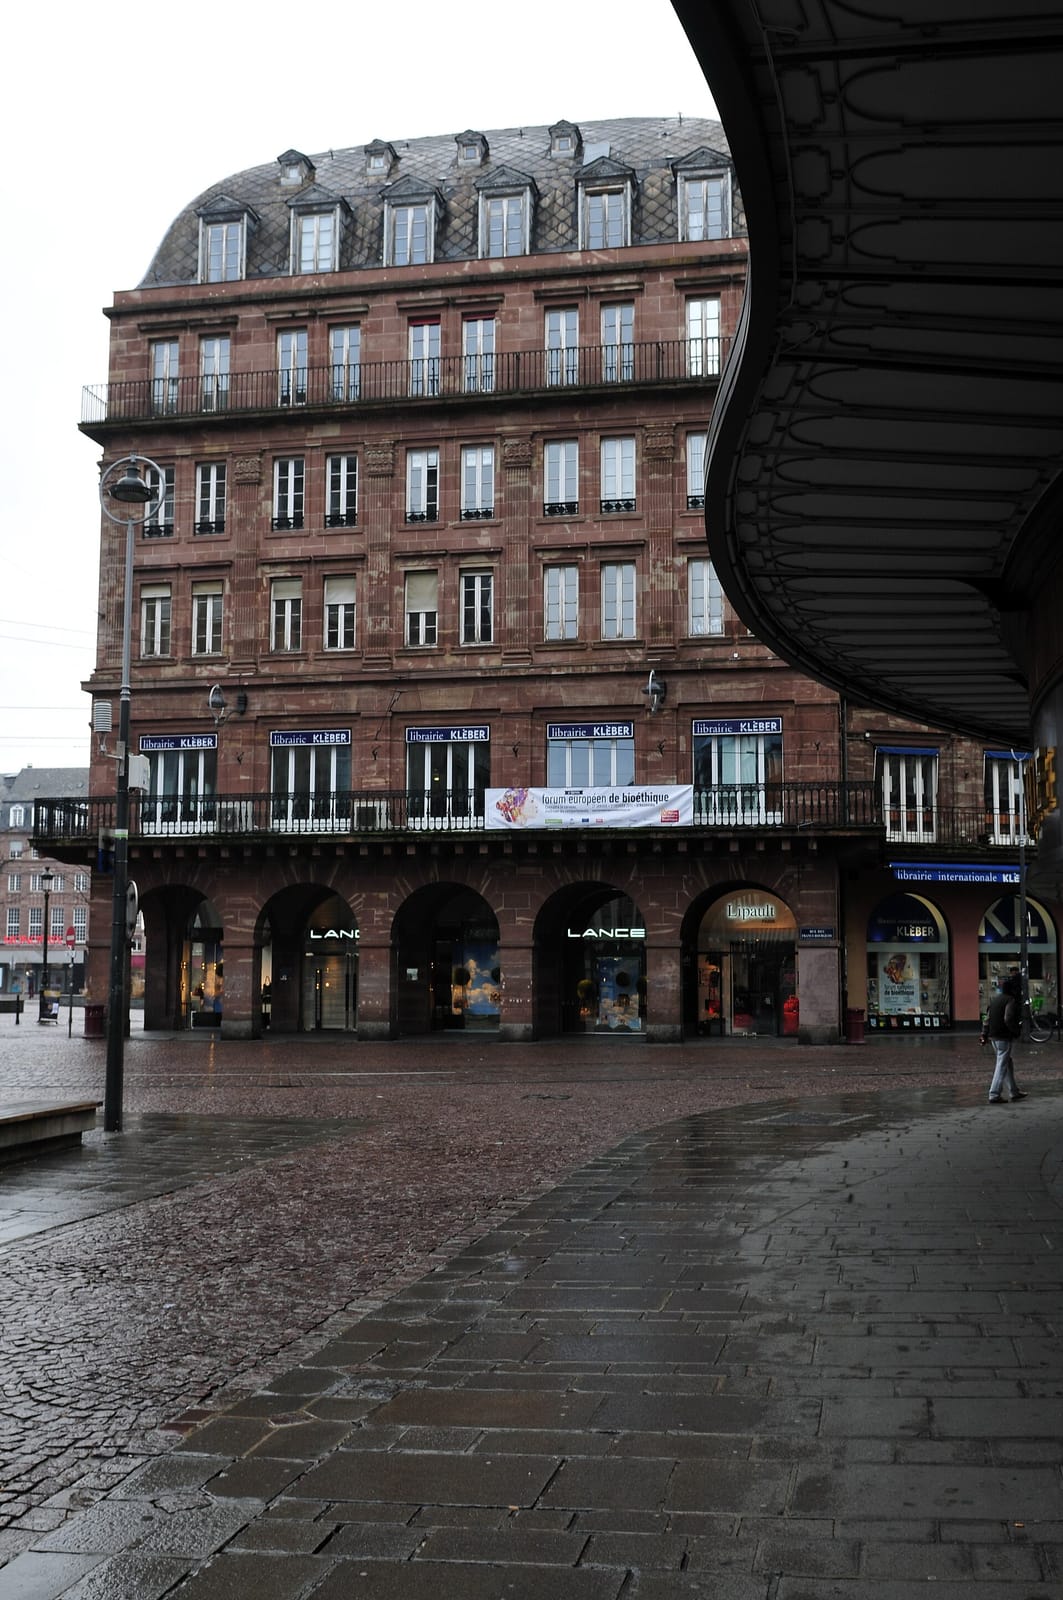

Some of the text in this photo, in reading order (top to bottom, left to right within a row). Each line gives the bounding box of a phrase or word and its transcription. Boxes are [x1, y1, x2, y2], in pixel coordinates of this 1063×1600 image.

[551, 727, 586, 737] librairie
[697, 723, 732, 733] librairie
[274, 735, 306, 744] librairie
[410, 731, 443, 740] librairie
[143, 739, 174, 748] librairie
[542, 794, 566, 804] forum
[568, 793, 606, 806] européen
[609, 793, 619, 803] de
[622, 792, 669, 804] bioéthique
[897, 869, 932, 880] librairie
[938, 871, 997, 882] internationale
[727, 904, 775, 920] Lipault
[567, 928, 646, 938] LANCE
